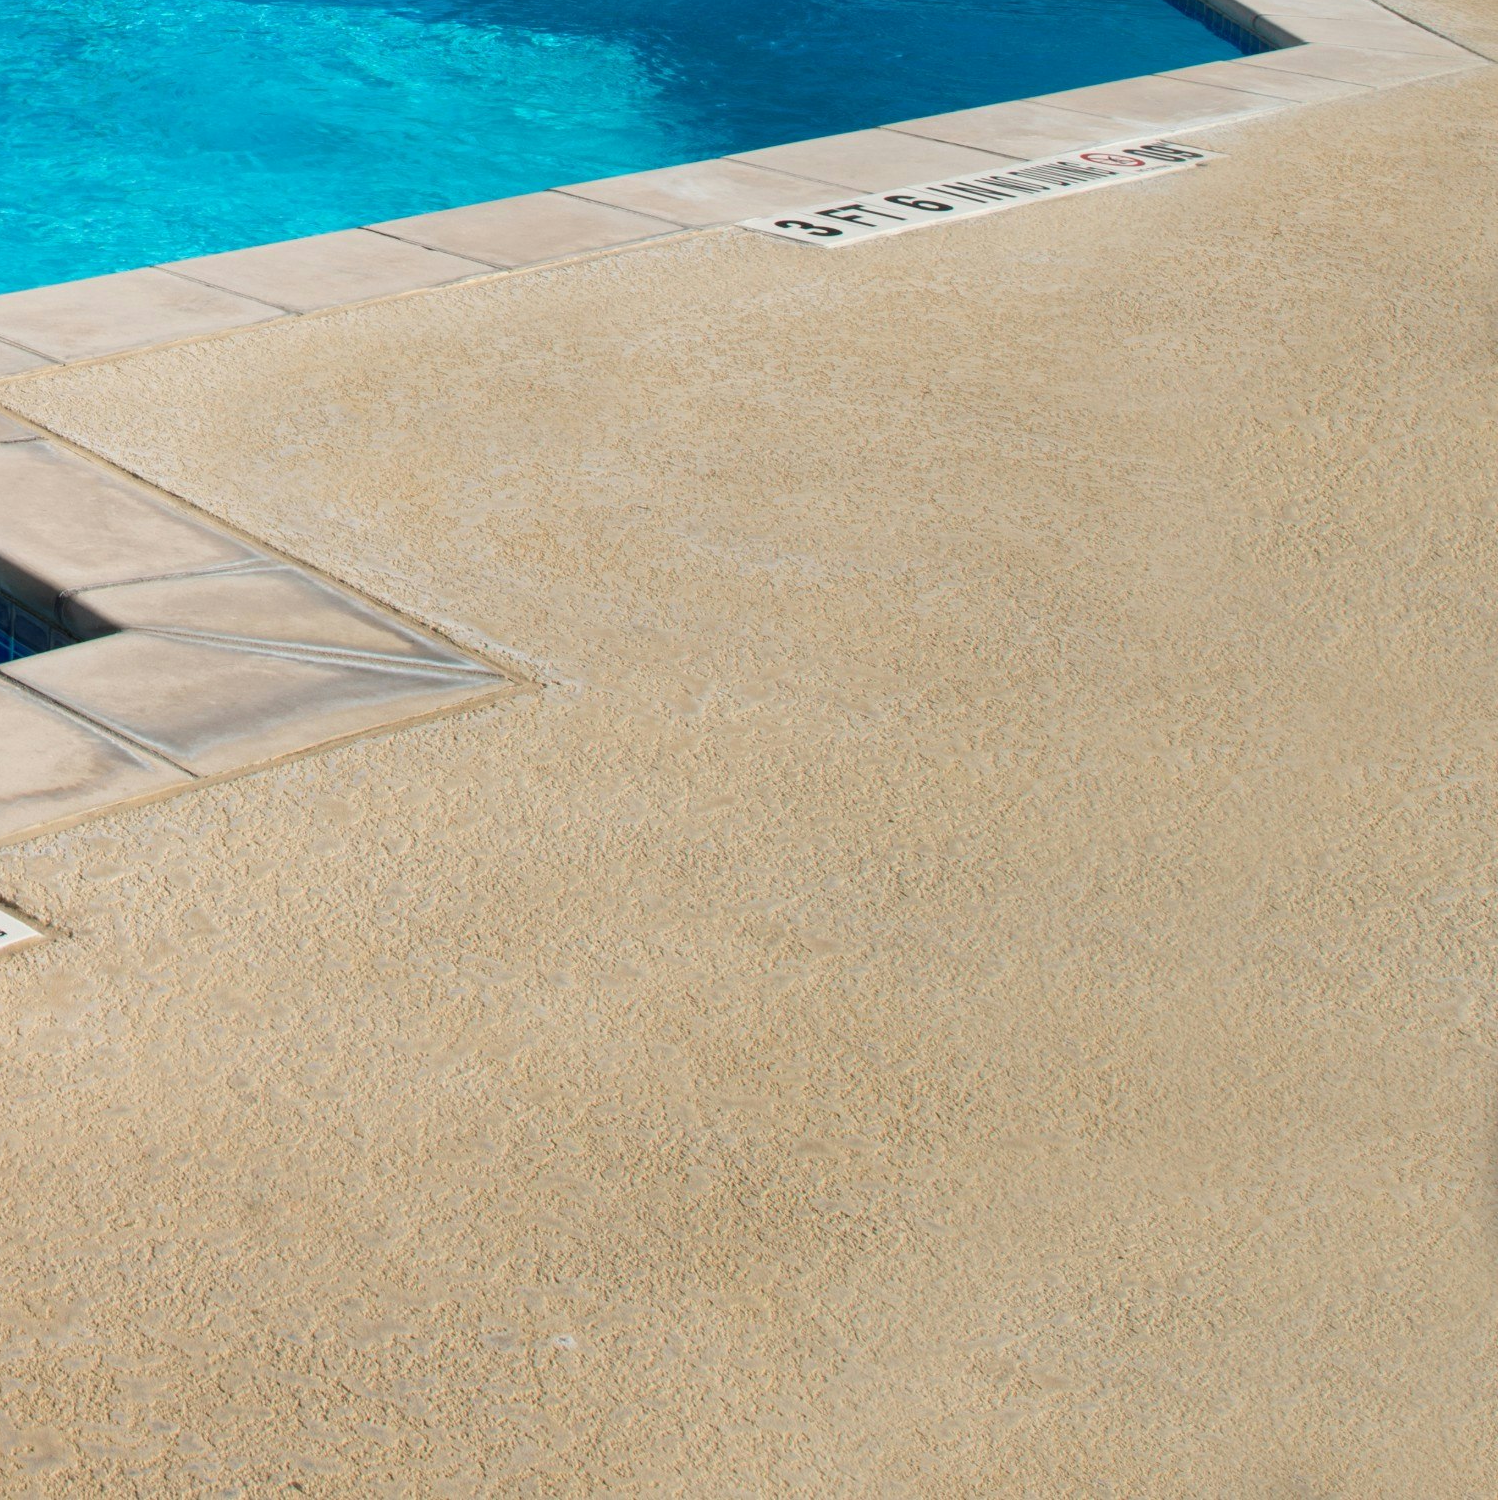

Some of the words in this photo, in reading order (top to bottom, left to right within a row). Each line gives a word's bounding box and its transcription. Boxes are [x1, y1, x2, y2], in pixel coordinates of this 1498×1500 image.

[1008, 160, 1117, 187] DIVING
[926, 181, 1017, 204] IN
[974, 175, 1050, 195] NO
[883, 194, 954, 212] 6
[815, 204, 907, 227] FT
[774, 219, 843, 237] 3
